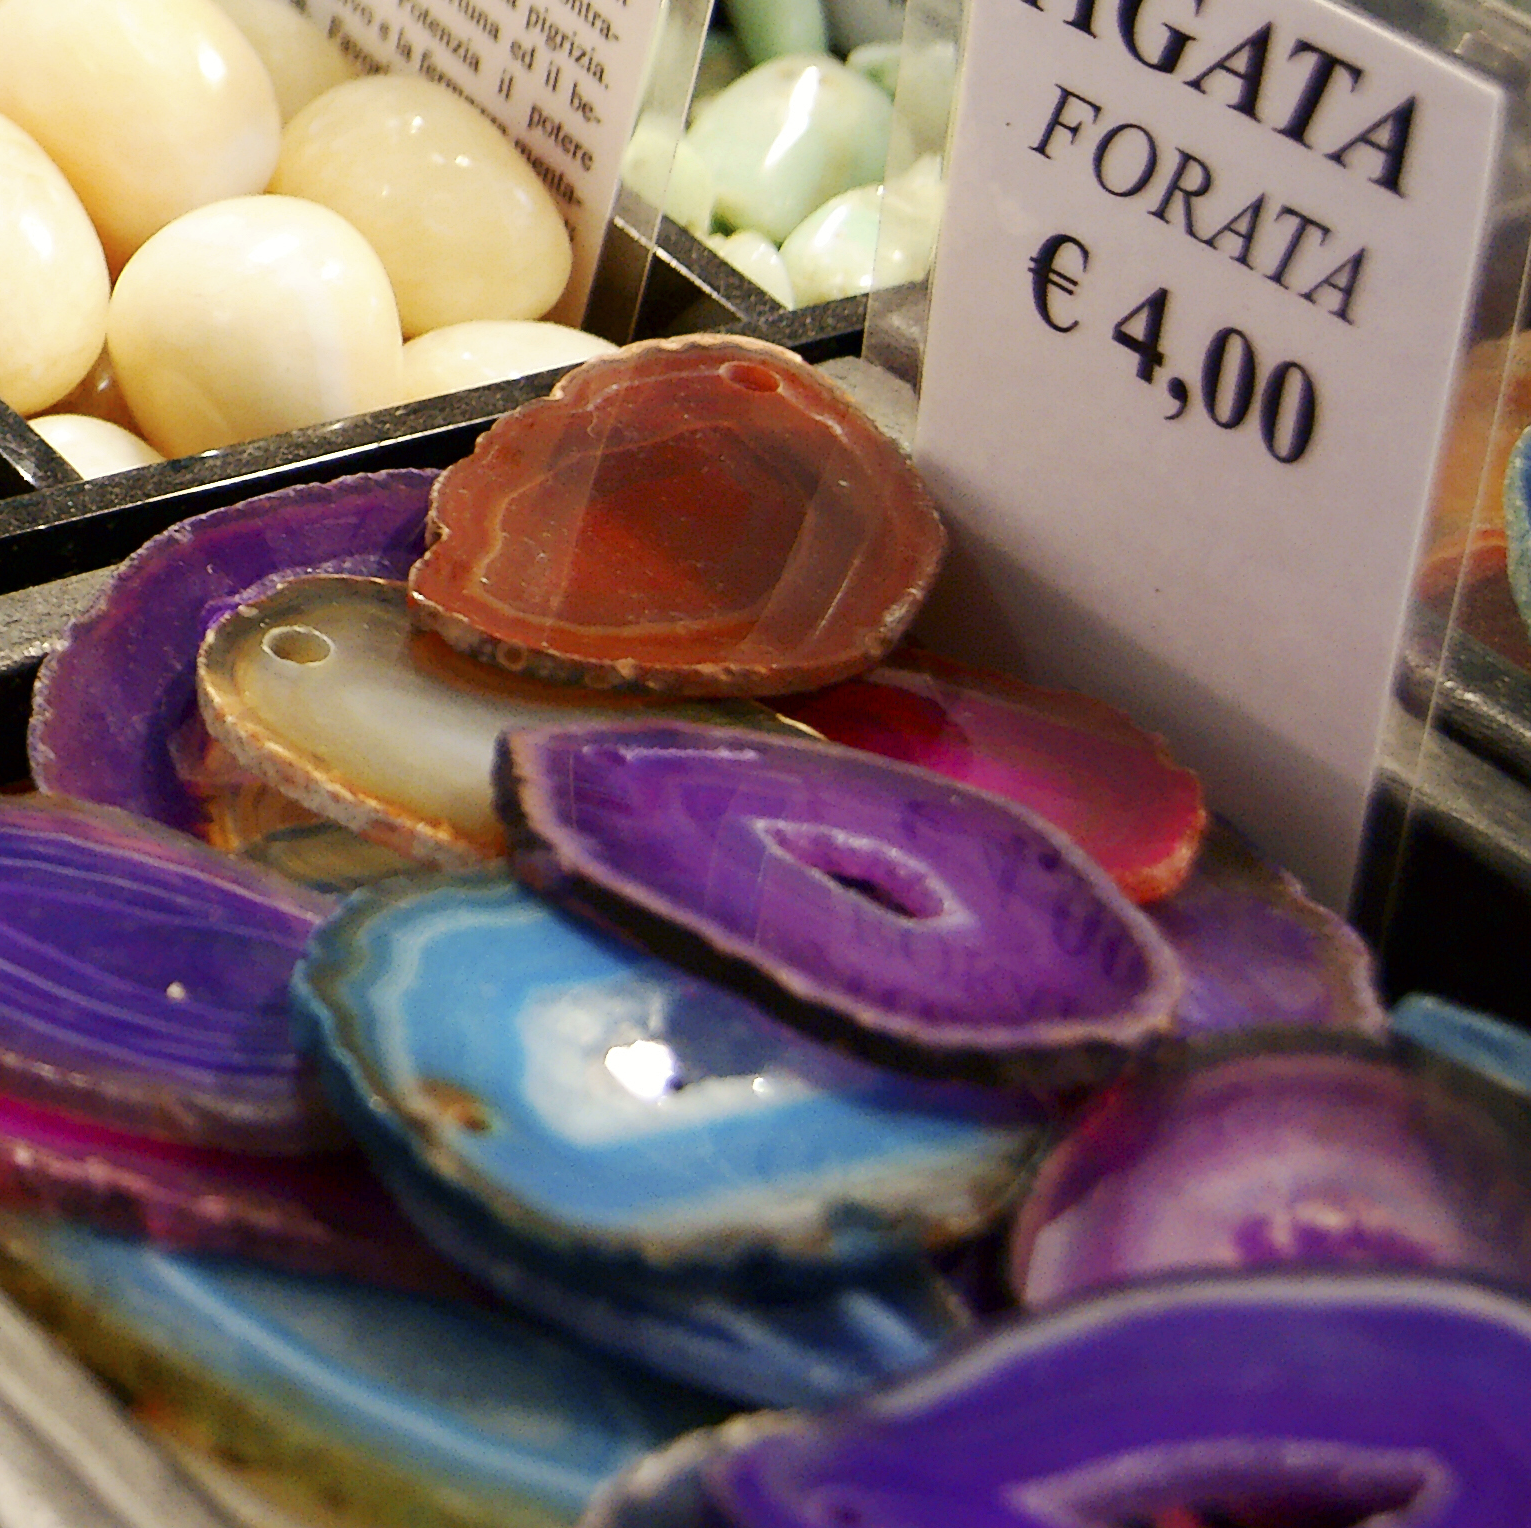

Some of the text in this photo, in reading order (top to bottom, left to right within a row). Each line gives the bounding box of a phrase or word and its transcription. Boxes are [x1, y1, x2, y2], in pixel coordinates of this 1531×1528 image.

[508, 39, 537, 73] ed
[543, 60, 561, 93] il
[568, 79, 602, 125] be-
[523, 3, 609, 90] pigrizia.
[496, 74, 514, 102] il
[525, 102, 594, 173] potere
[1027, 82, 1369, 327] FORATA
[1026, 232, 1321, 466] € 4,00
